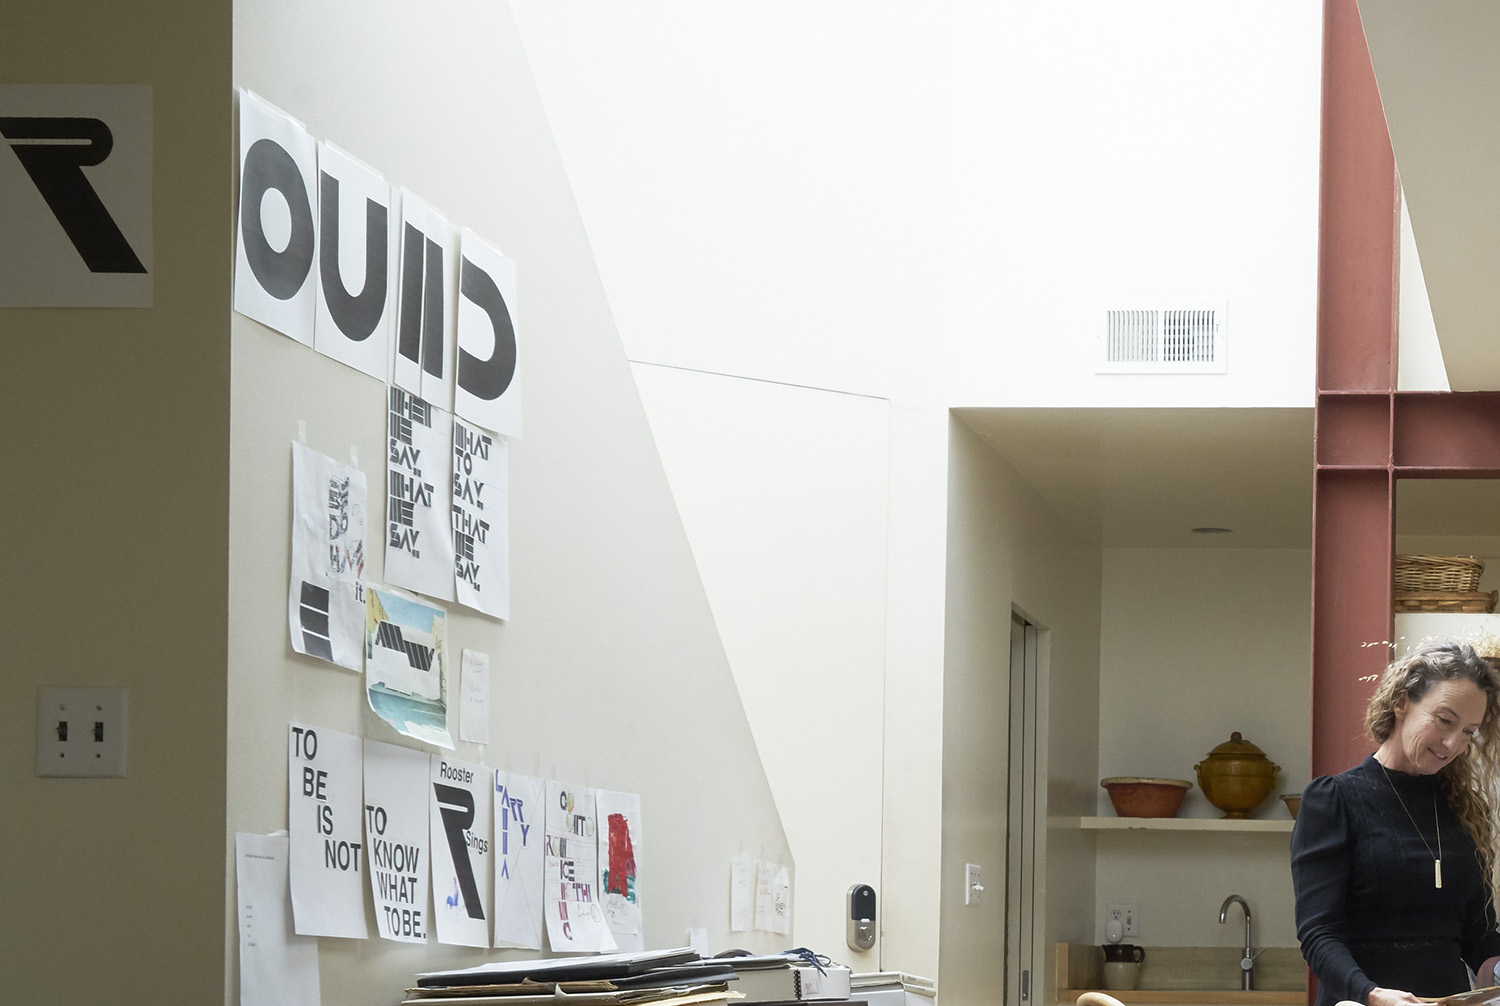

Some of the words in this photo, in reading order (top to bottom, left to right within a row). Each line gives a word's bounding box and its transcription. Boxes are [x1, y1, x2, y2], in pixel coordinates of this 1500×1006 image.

[292, 727, 318, 761] TO
[303, 767, 328, 800] BE
[440, 762, 475, 784] Rooster
[317, 805, 333, 835] IS
[366, 805, 387, 835] TO
[325, 839, 361, 872] NOT
[465, 828, 488, 855] Sings
[373, 842, 419, 875] KNOW
[376, 870, 417, 904] WHAT
[384, 905, 401, 937] TO
